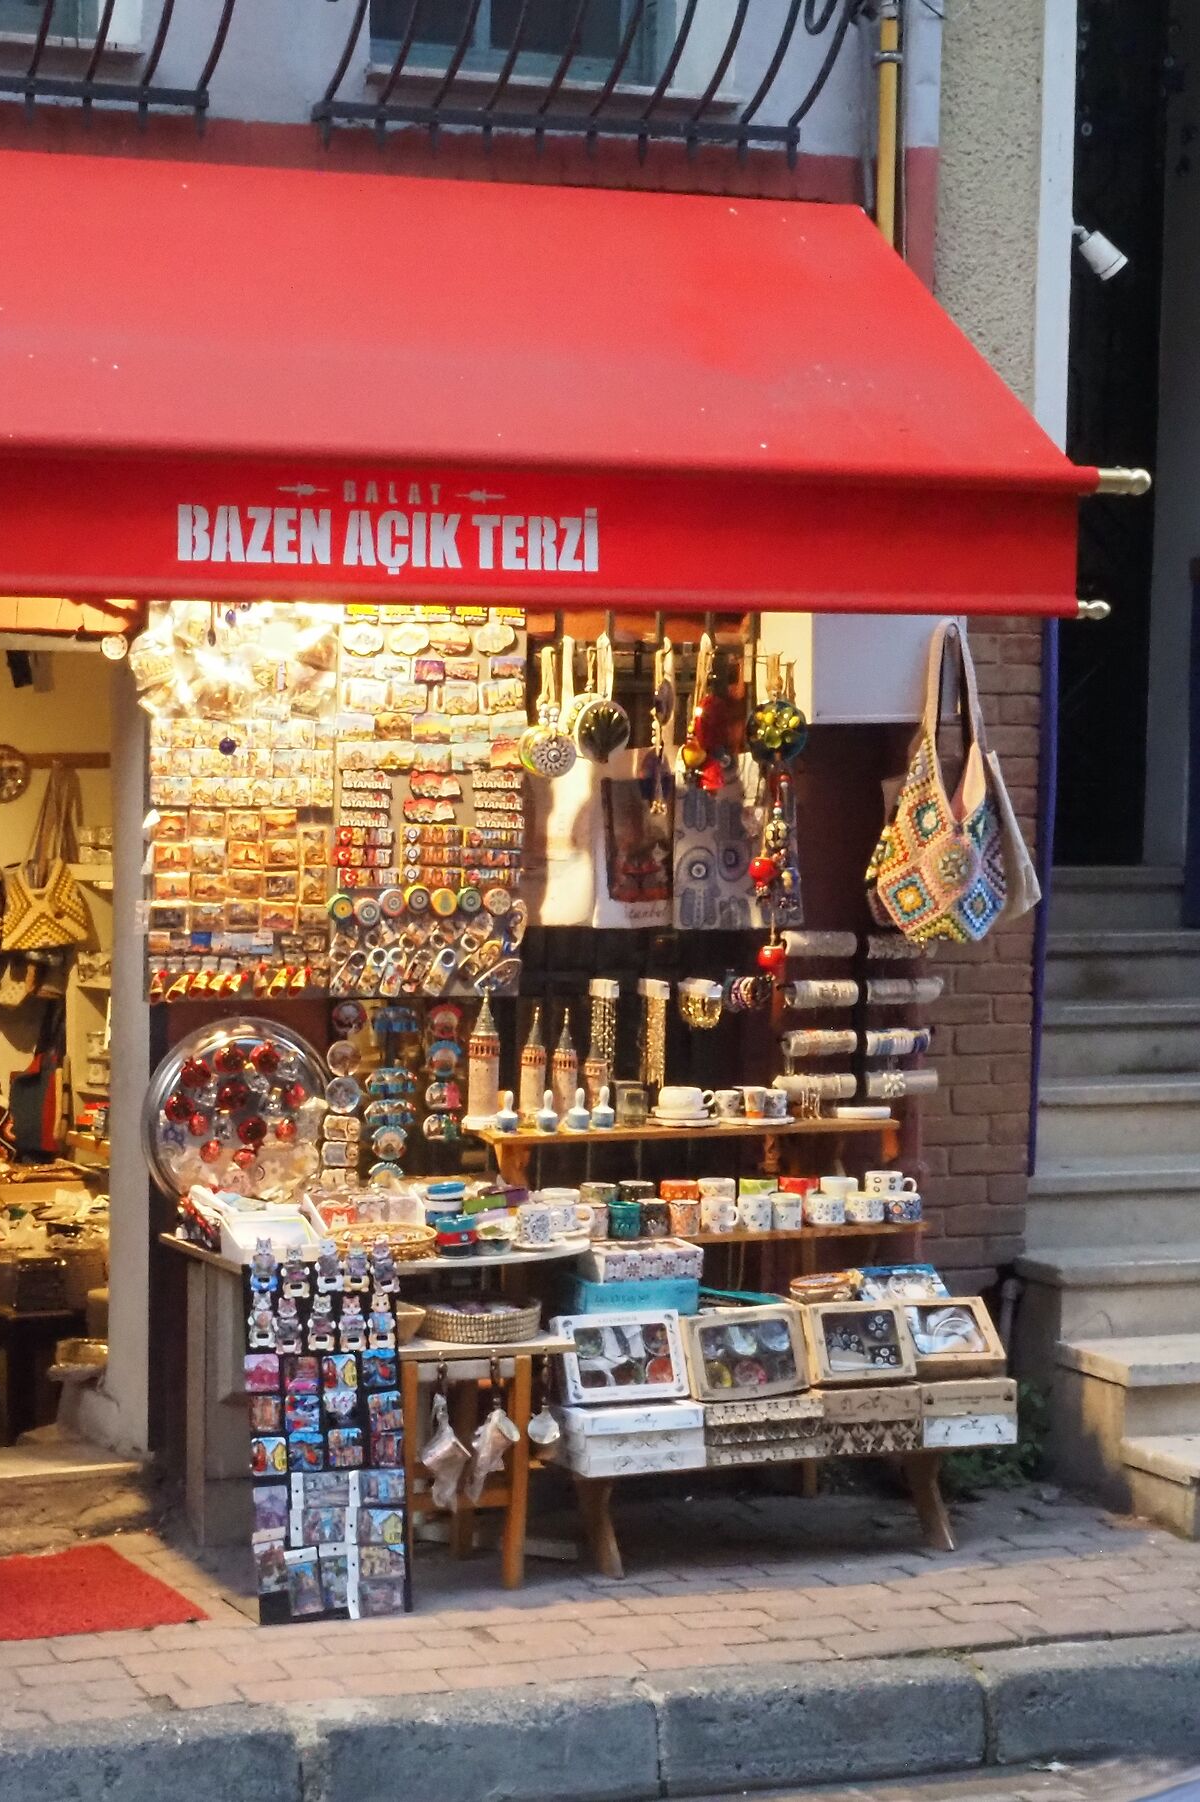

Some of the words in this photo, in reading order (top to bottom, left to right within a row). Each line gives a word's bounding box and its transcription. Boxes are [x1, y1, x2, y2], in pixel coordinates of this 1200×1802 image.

[343, 480, 441, 505] BALAT
[177, 503, 332, 565] BAZEN
[343, 510, 462, 575] AÇIK
[472, 507, 599, 573] TERZİ
